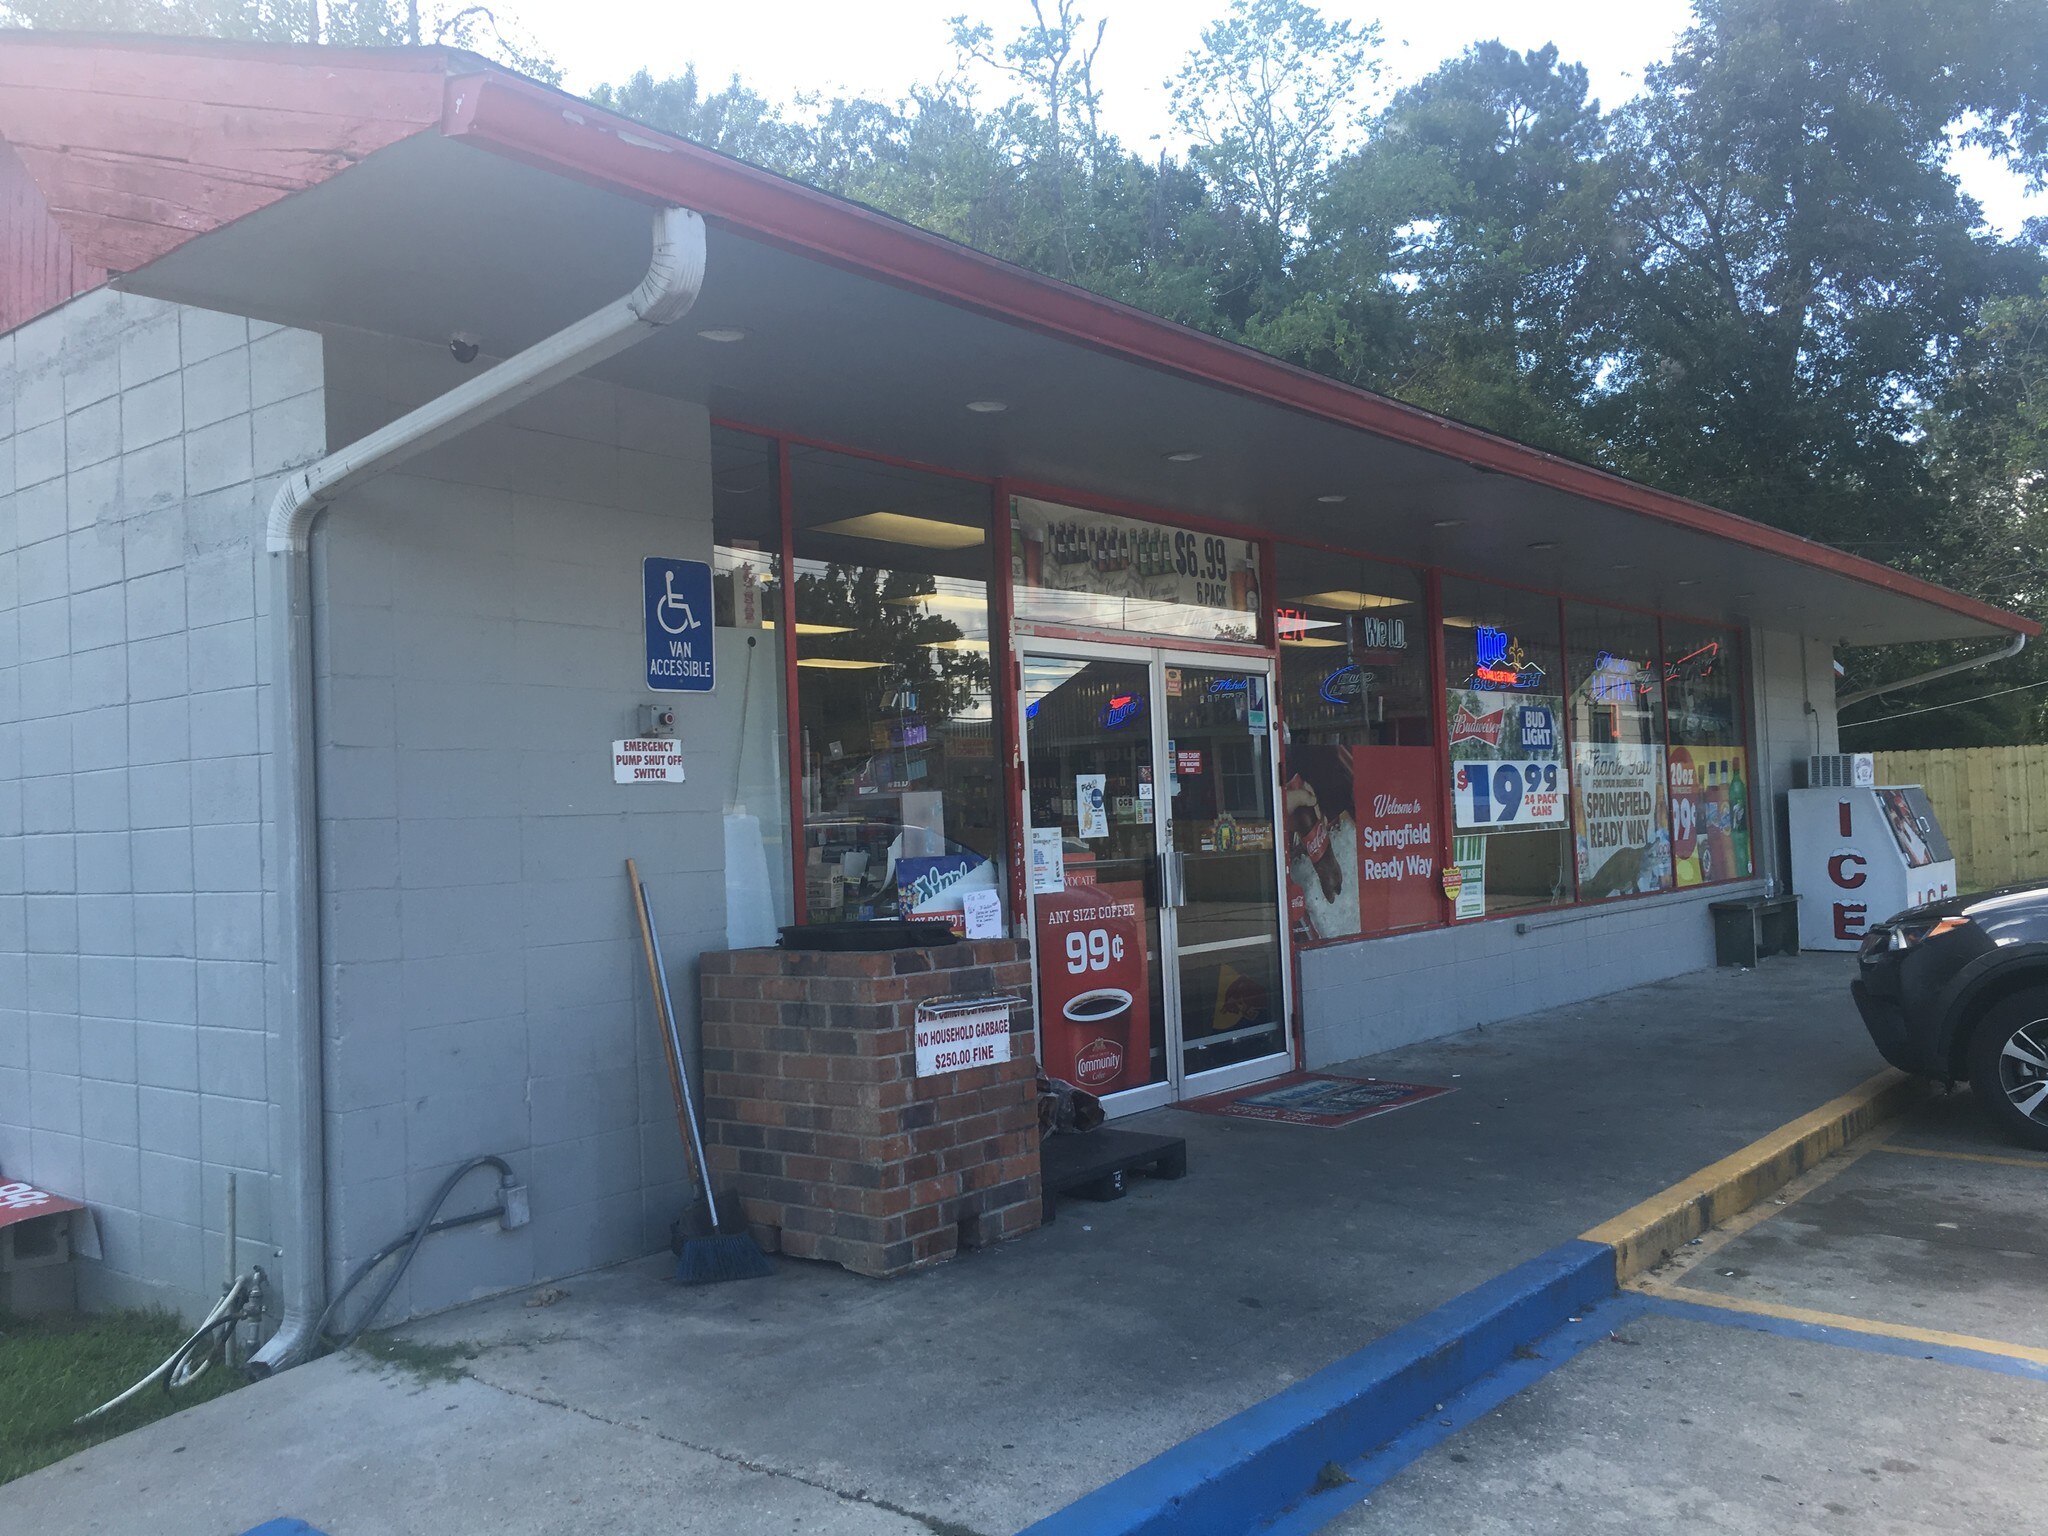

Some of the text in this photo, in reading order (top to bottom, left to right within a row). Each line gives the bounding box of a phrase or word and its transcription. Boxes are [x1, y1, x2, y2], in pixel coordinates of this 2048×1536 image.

[1174, 531, 1227, 581] $6.99
[1196, 582, 1202, 603] 6
[1204, 584, 1227, 607] PACK
[669, 641, 692, 658] VAN
[650, 659, 711, 678] ACCESSIBLE
[1453, 713, 1501, 735] Budweiser
[1525, 711, 1545, 727] BUD
[623, 741, 674, 753] EMERGENCY
[1522, 728, 1550, 745] LIGHT
[616, 754, 683, 766] PUMP SHUT OFF
[1584, 750, 1624, 776] Thank
[634, 768, 666, 780] SWITCH
[1593, 778, 1644, 788] FOR YOUR BUSINESS AT
[1373, 794, 1421, 818] Welcome to
[1525, 794, 1558, 806] 24 PACK
[1532, 806, 1552, 817] CANS
[1587, 791, 1650, 819] SPRINGFIELD
[1364, 823, 1431, 851] Springfield
[1590, 819, 1649, 848] READY WAY
[1365, 855, 1403, 881] Ready
[1406, 855, 1432, 878] Way
[1827, 796, 1867, 941] ICE
[1064, 875, 1095, 887] VOCATE
[1048, 904, 1135, 925] ANY SIZE COFFEE
[1065, 928, 1124, 975] 99¢
[918, 1018, 1009, 1047] NO HOUSEHOLD GARBAGE
[935, 1044, 994, 1070] $250.00 FINE
[1078, 1052, 1120, 1077] Community
